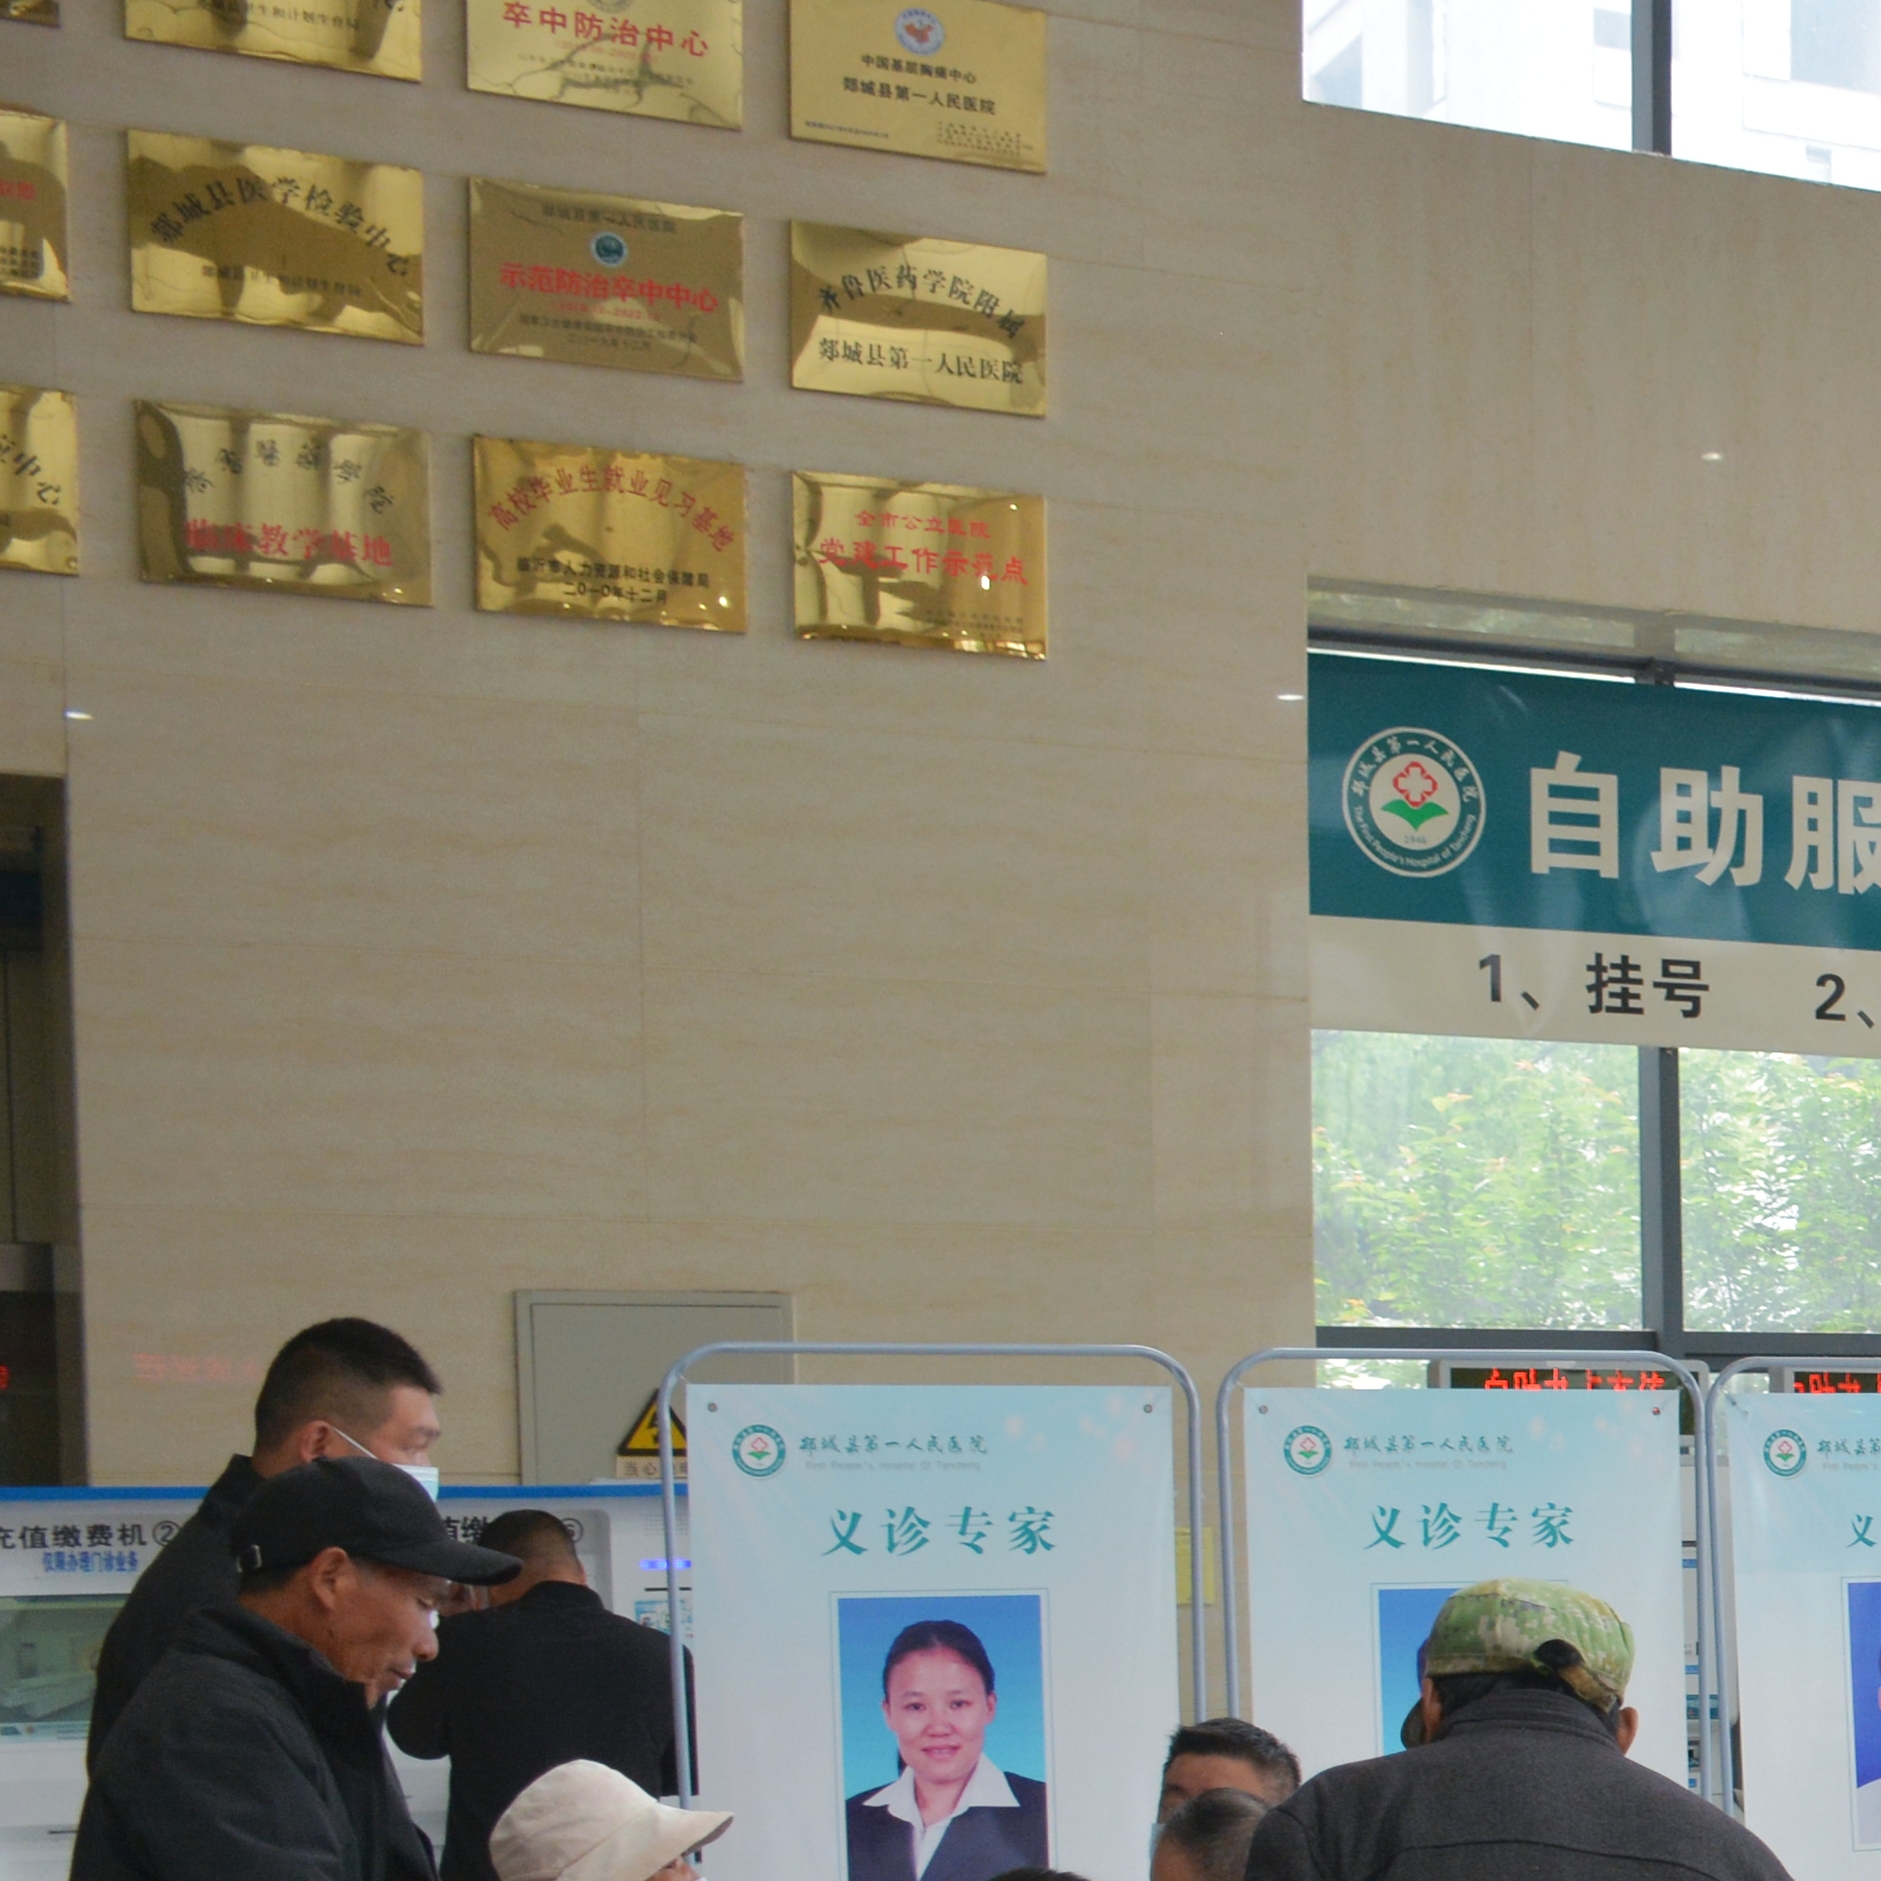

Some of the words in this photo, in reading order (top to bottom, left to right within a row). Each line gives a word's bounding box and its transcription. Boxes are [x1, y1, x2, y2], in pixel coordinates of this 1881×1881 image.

[503, 1, 709, 57] 卒中防治中心
[861, 53, 977, 85] 中国基层胸痛中心
[843, 77, 996, 115] 郯城县第一人民医院
[151, 175, 409, 277] 郯城县医学检验中心
[500, 261, 718, 312] 示范防治卒中中心
[819, 264, 1025, 338] 齐鲁医药学院附属
[819, 337, 1023, 385] 郯城县第一人民医院
[488, 464, 736, 552] 高校毕业生就业见习基地
[855, 509, 991, 540] 全市公立医院
[186, 519, 393, 567] 临床教学基地
[818, 537, 1029, 586] 党建工作示范点
[1477, 953, 1711, 1020] 1、挂号
[822, 1506, 1057, 1557] 义诊专家
[1364, 1501, 1575, 1550] 义诊专家
[42, 1551, 138, 1572] 仅限办理门诊业务
